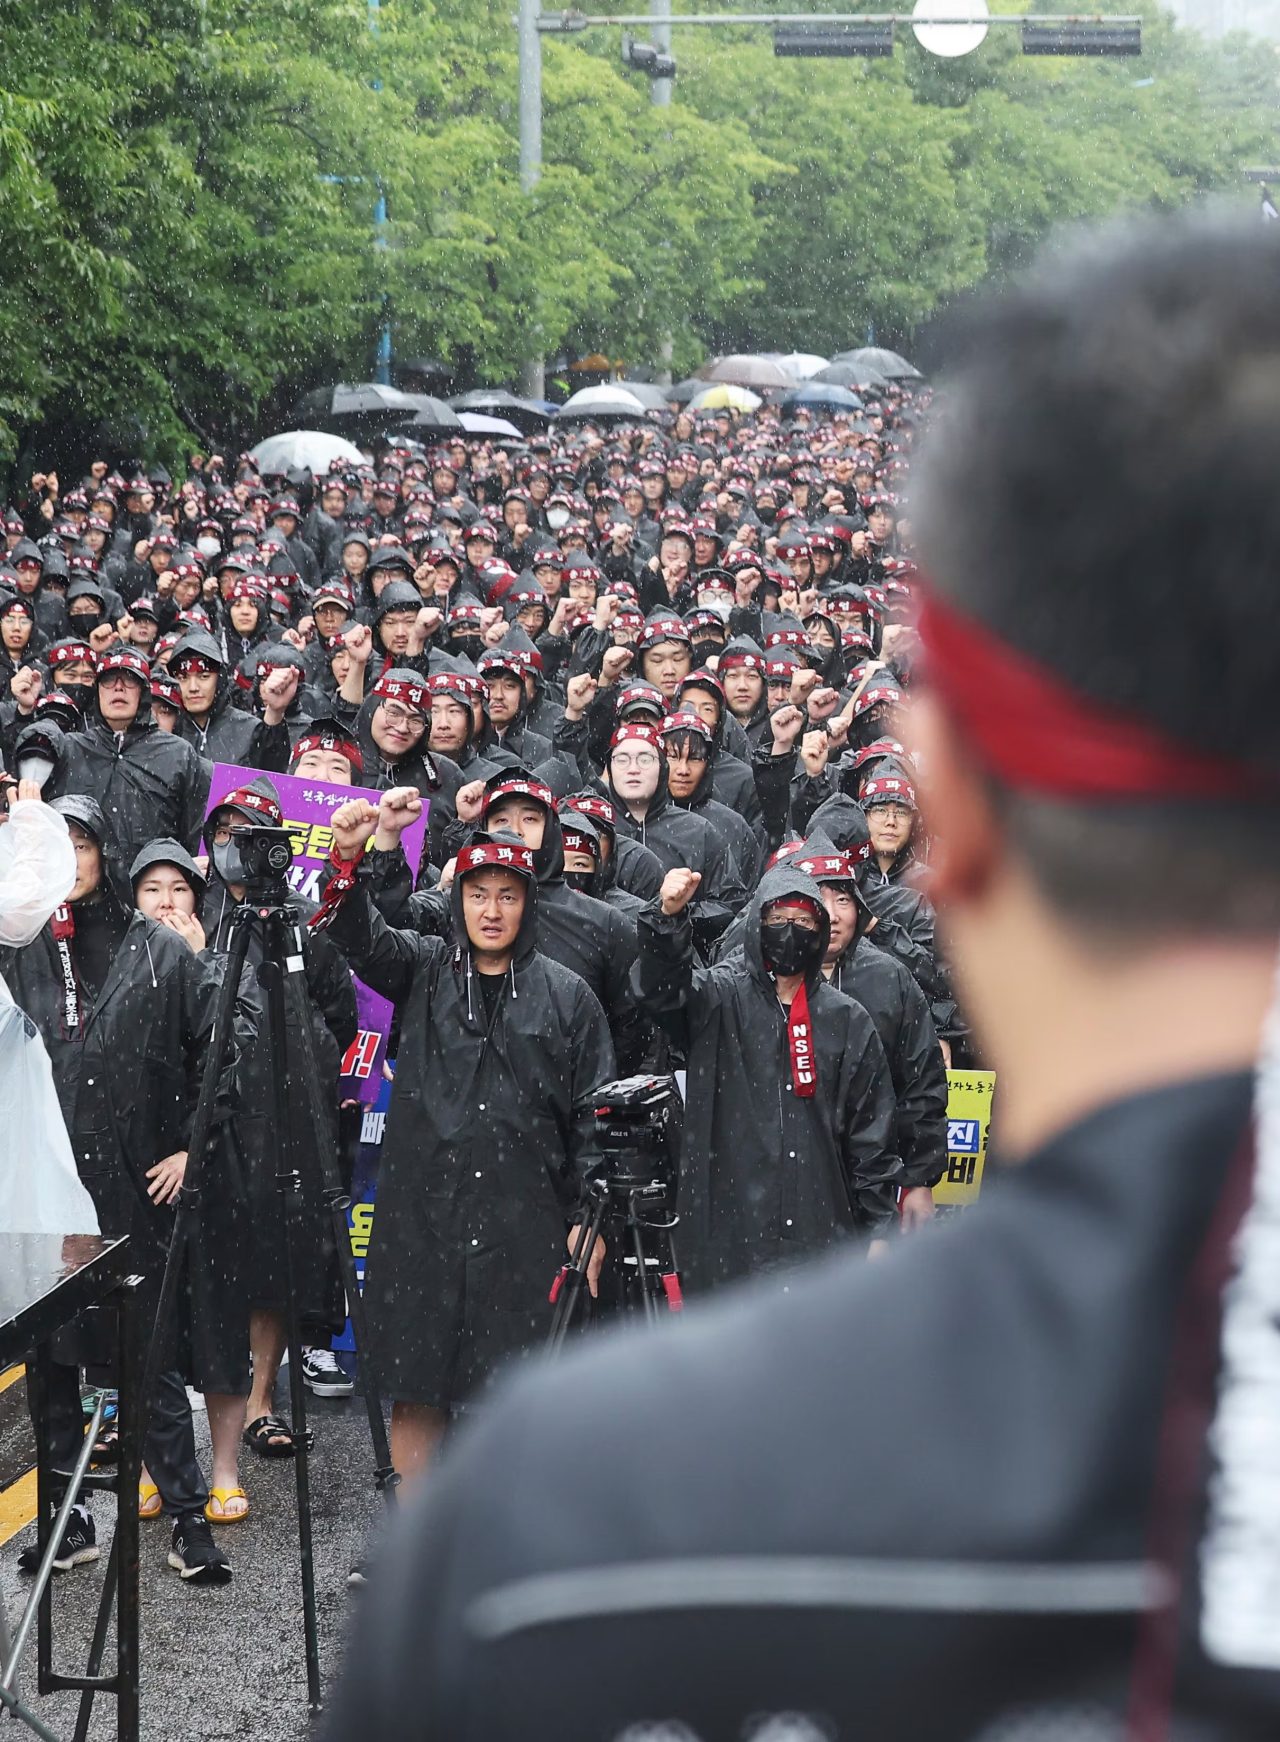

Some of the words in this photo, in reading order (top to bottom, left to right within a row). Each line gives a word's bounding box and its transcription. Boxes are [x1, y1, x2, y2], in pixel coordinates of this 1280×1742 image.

[426, 674, 466, 692] 파업
[289, 737, 335, 764] 파업
[469, 847, 533, 866] 총파업
[792, 1024, 813, 1084] NSEU
